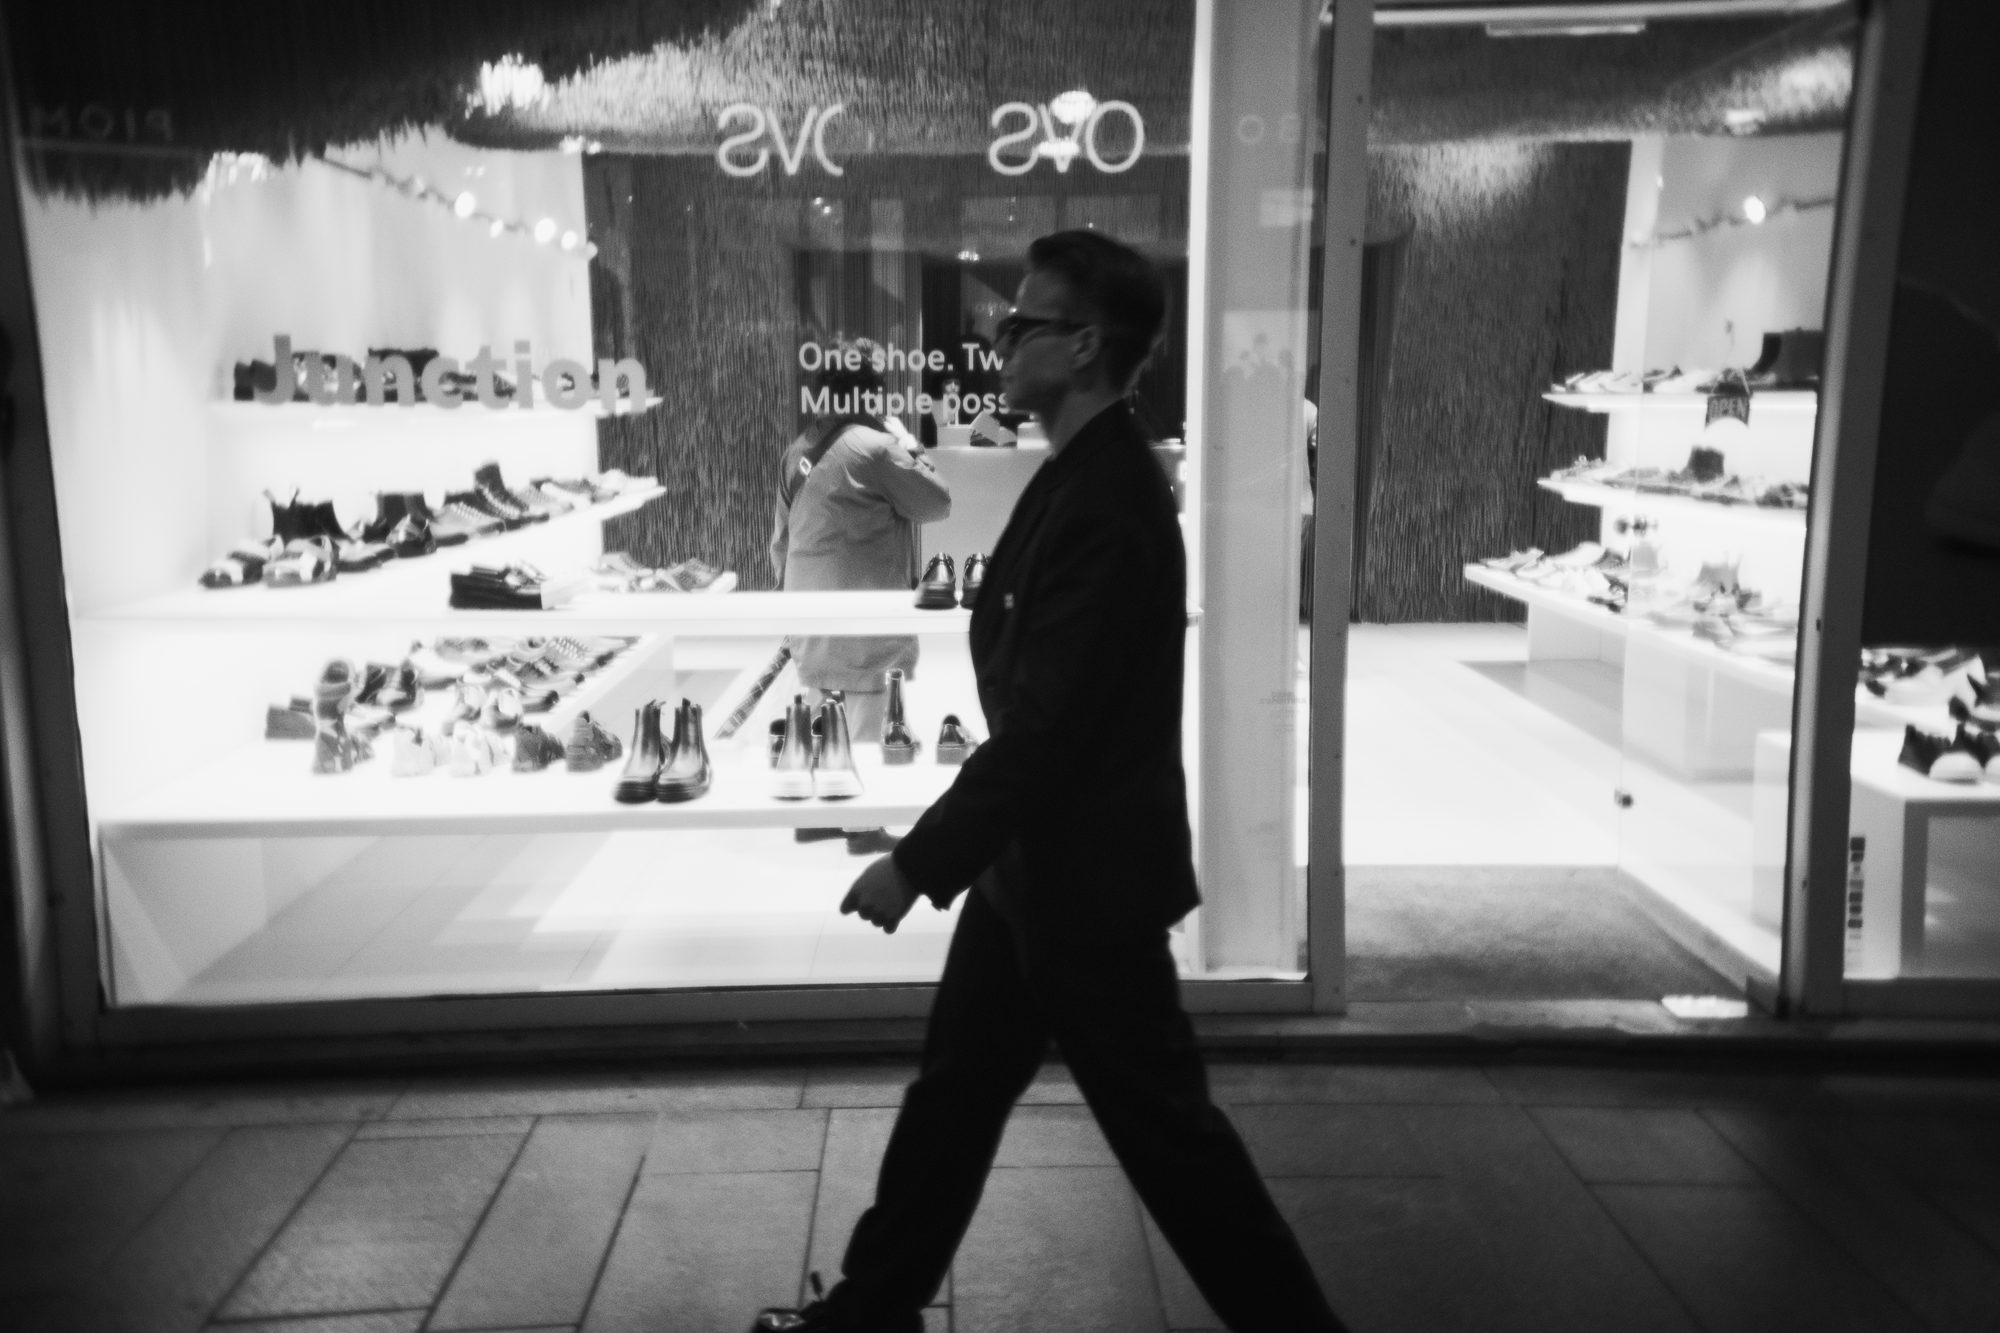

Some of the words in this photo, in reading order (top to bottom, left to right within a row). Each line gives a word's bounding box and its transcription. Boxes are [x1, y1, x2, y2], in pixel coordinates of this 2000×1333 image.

[253, 334, 648, 412] Junction
[798, 341, 862, 371] One
[871, 342, 954, 373] shoe.
[961, 342, 1004, 371] Tw
[800, 386, 933, 421] Multiple
[942, 391, 1010, 424] poss
